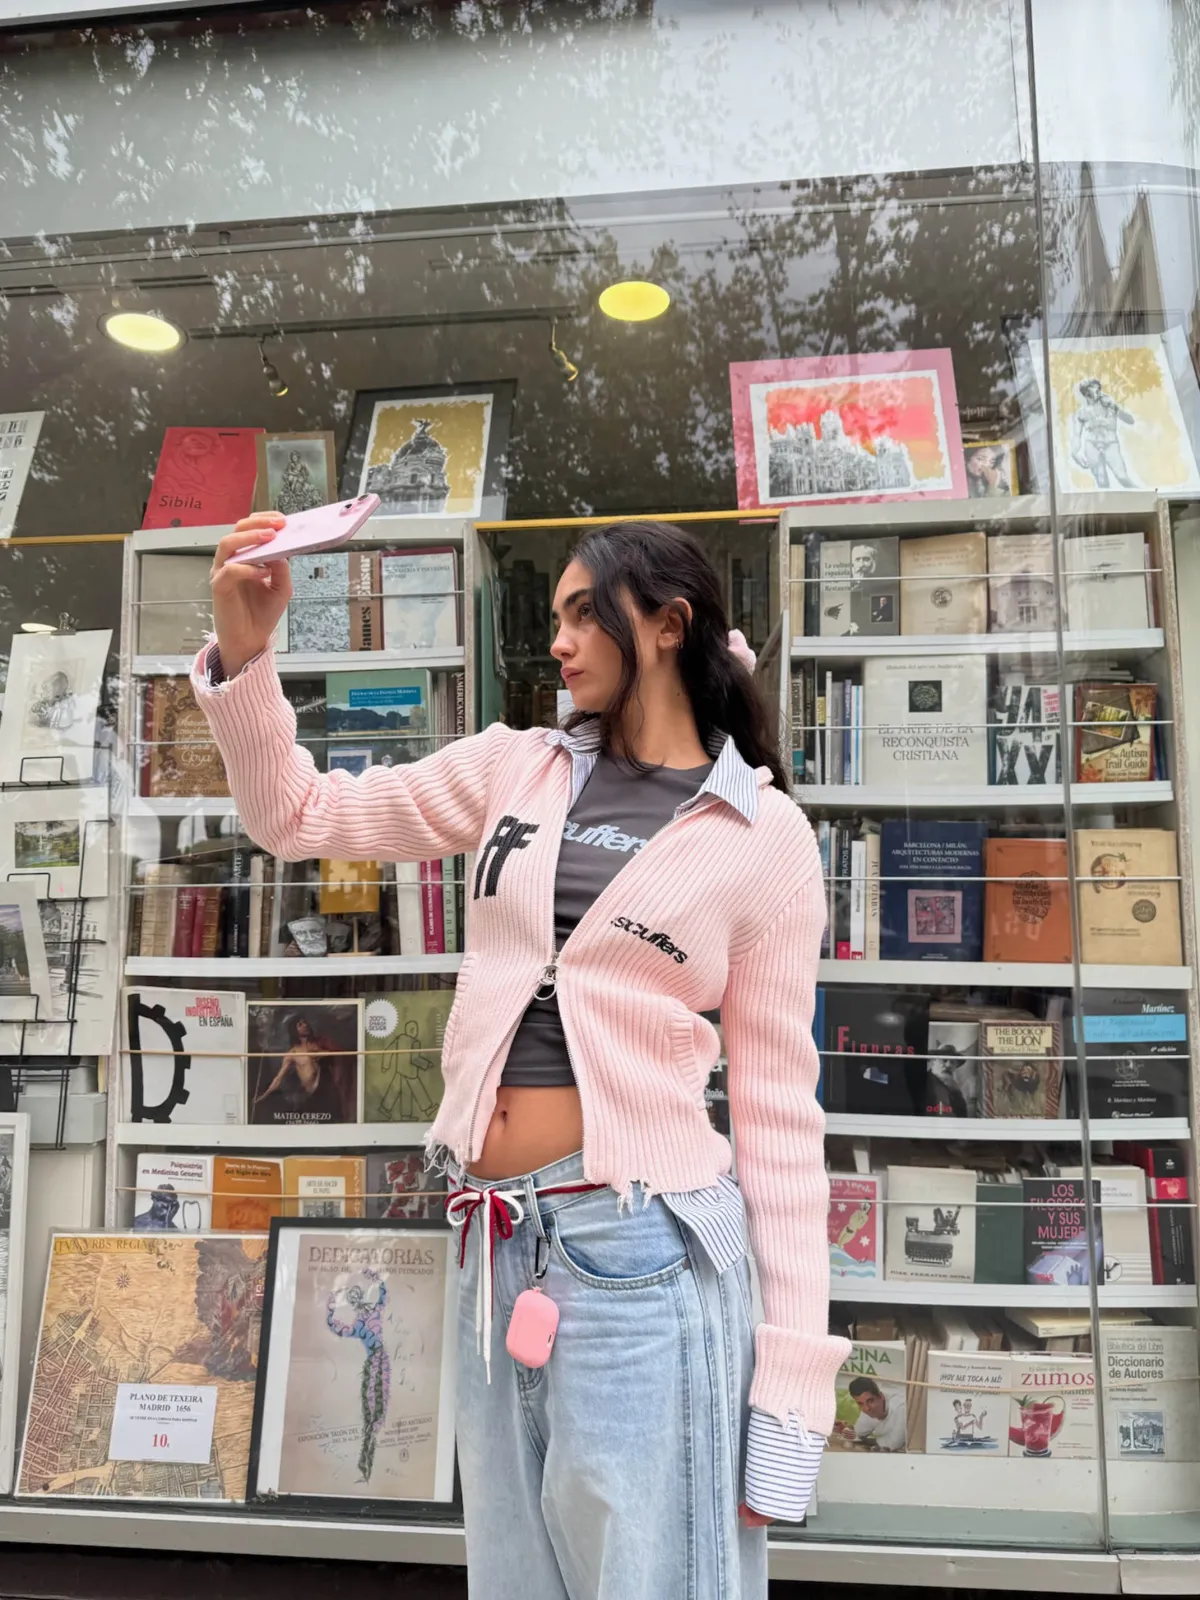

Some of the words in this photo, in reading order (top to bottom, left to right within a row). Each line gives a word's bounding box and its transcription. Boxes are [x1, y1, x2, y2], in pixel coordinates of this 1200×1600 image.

[158, 495, 202, 509] Sibila
[456, 716, 464, 734] GLAS
[882, 736, 970, 749] RECONQUISTA
[892, 750, 959, 761] CRISTIANA
[1120, 748, 1148, 758] Autism
[1104, 758, 1122, 769] Trail
[1123, 758, 1148, 769] Guide
[841, 850, 849, 888] RTRATOS
[1141, 1003, 1176, 1014] Martínez
[198, 1016, 208, 1027] EN
[209, 1014, 234, 1028] ESPAÑA
[994, 1028, 1010, 1036] THE
[1011, 1028, 1033, 1036] BOOK
[1033, 1027, 1046, 1035] OF
[836, 1024, 916, 1054] Figuras
[998, 1036, 1014, 1045] THE
[1015, 1036, 1041, 1046] LION
[273, 1112, 300, 1120] MATEO
[301, 1112, 332, 1120] CEREZO
[151, 1168, 179, 1176] Medicina
[180, 1170, 203, 1178] General
[1052, 1184, 1074, 1197] LOS
[1030, 1197, 1086, 1211] FILOSOFO
[1048, 1212, 1055, 1225] Y
[1059, 1212, 1081, 1225] SUS
[1038, 1225, 1085, 1240] MUJERE
[309, 1246, 435, 1265] DEDICATORIAS
[848, 1346, 892, 1364] CINA
[838, 1361, 878, 1376] ANA
[1107, 1356, 1164, 1368] Diccionario
[955, 1374, 966, 1382] ME
[967, 1374, 983, 1383] TOCA
[984, 1375, 990, 1383] A
[1021, 1372, 1095, 1386] zumos
[1108, 1367, 1121, 1378] de
[1124, 1368, 1164, 1379] Autores
[130, 1392, 156, 1402] PLANO
[157, 1394, 168, 1402] DE
[169, 1394, 203, 1404] TEXEIRA
[139, 1403, 171, 1412] MADRID
[176, 1404, 192, 1413] 1656
